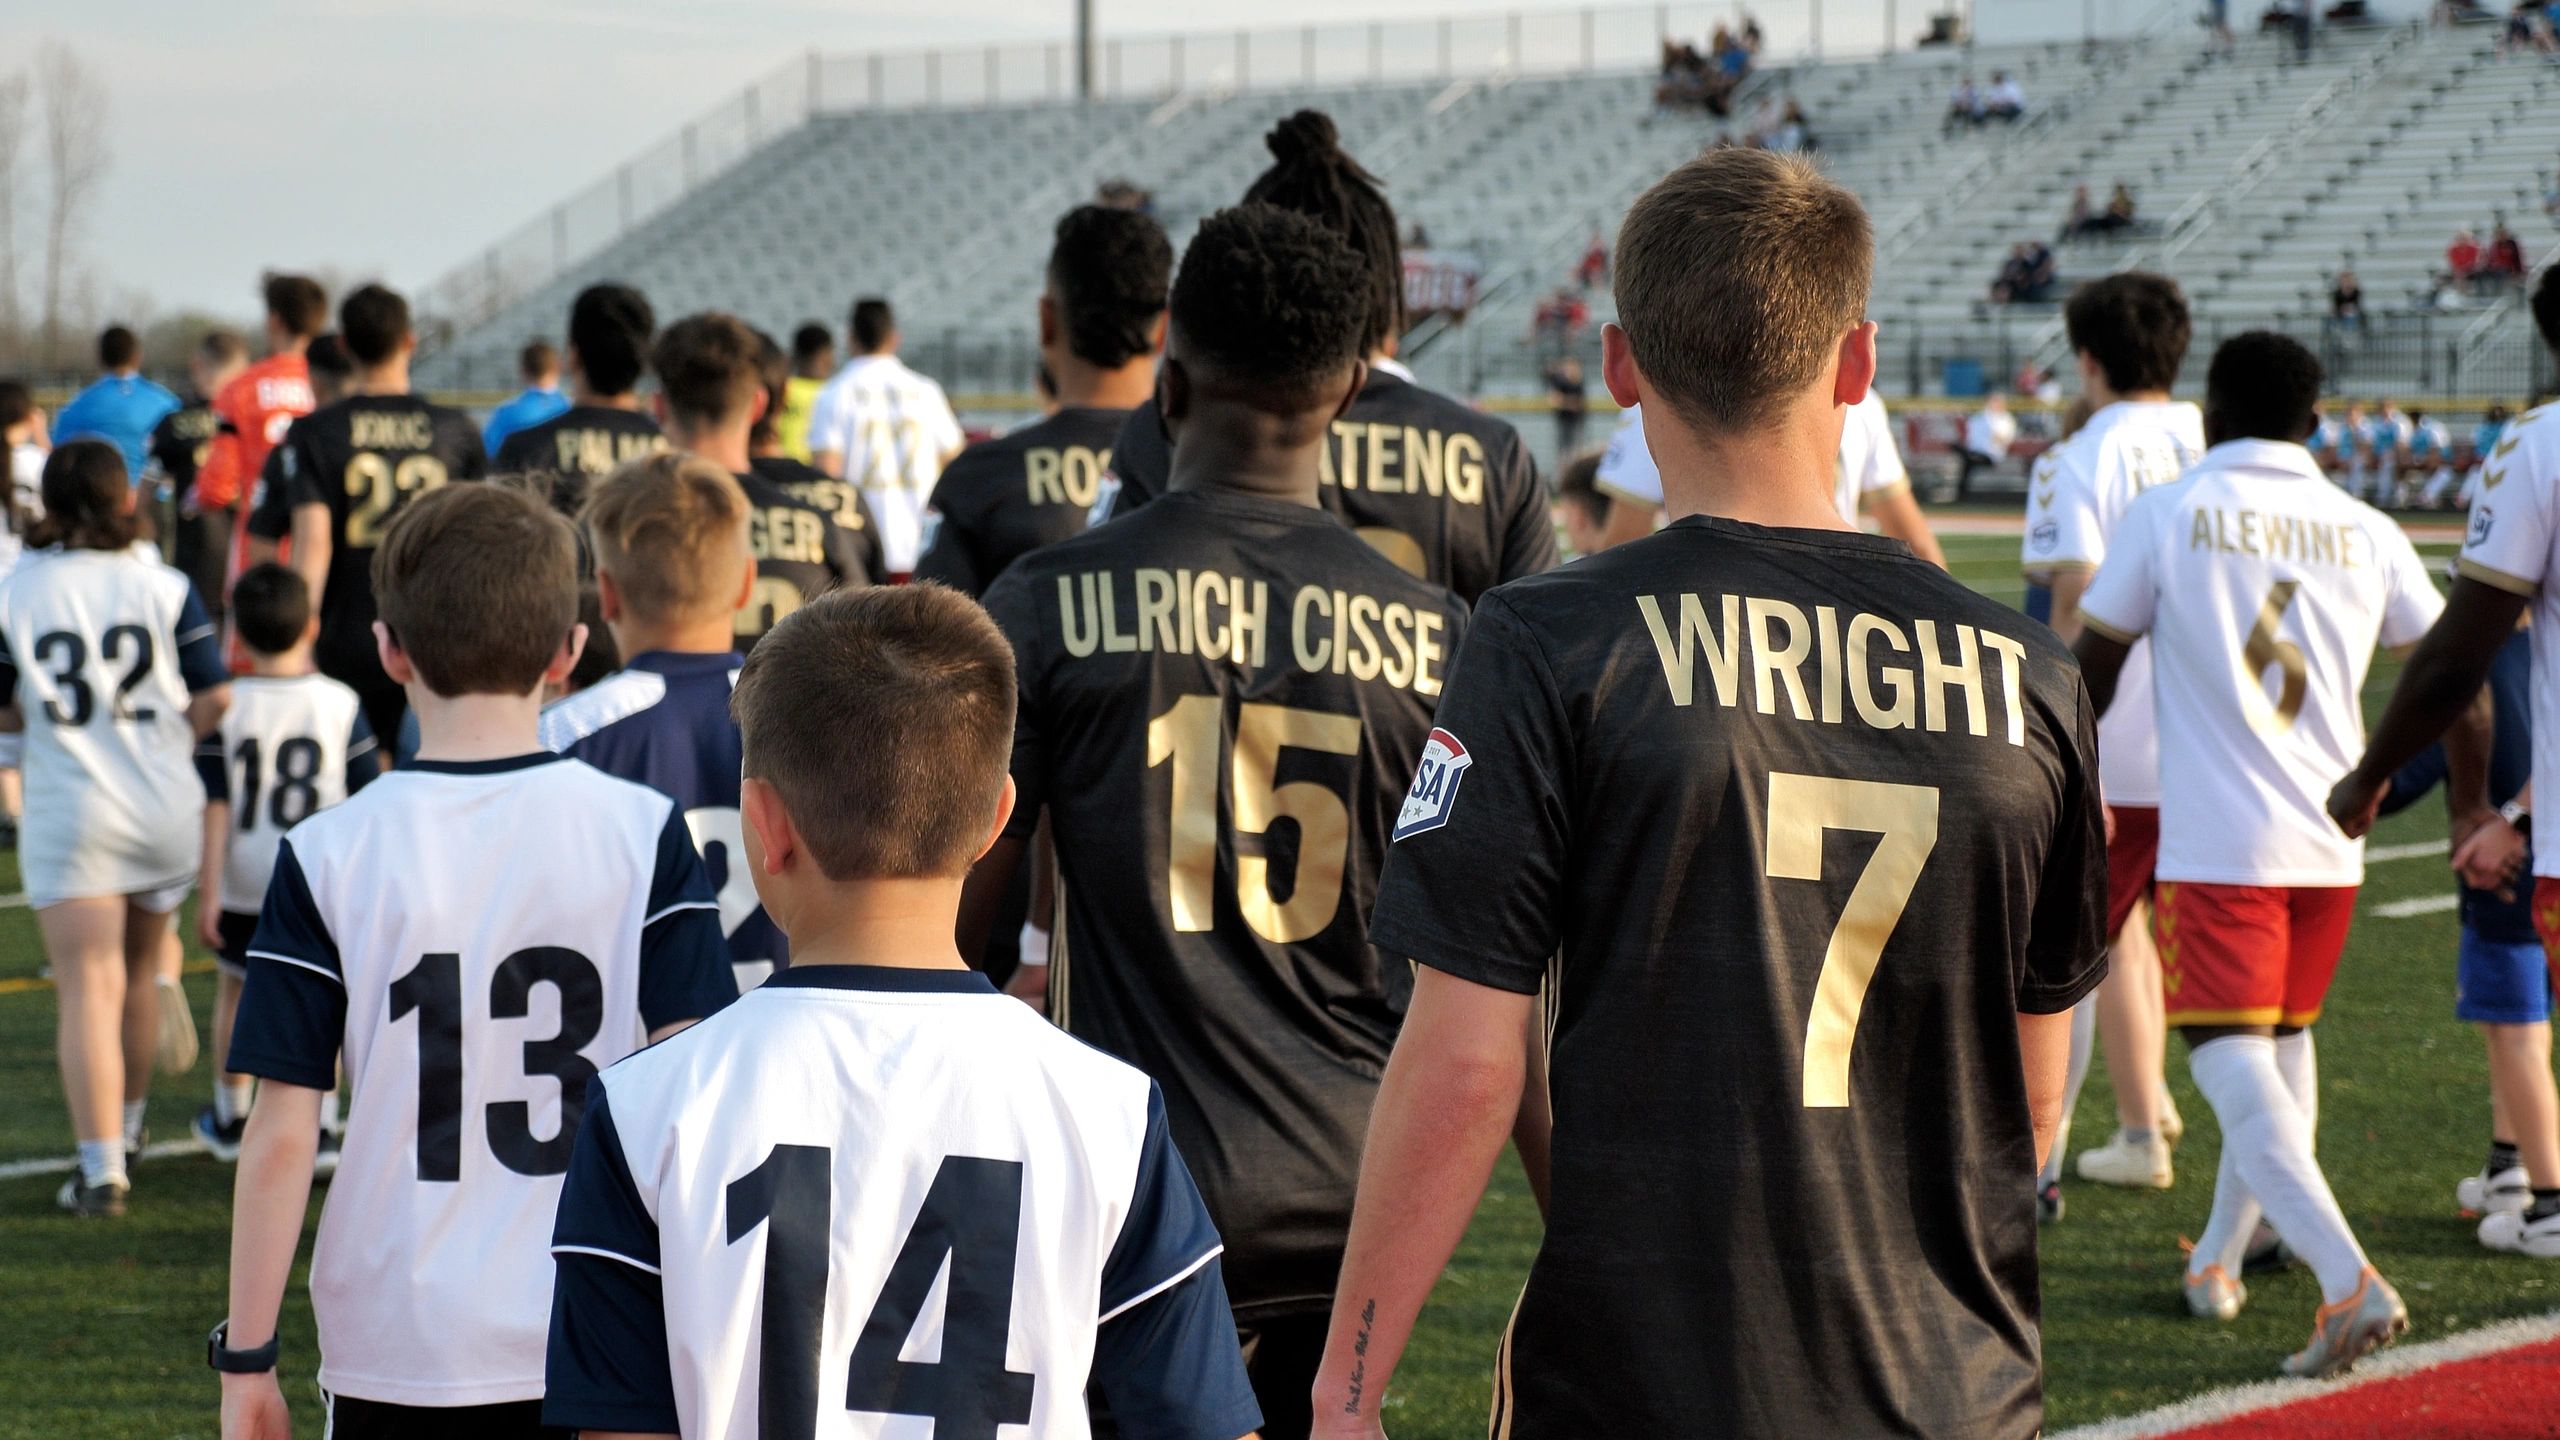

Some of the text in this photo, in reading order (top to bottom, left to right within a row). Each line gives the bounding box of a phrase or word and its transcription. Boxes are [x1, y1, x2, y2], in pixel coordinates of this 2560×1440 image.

[2190, 506, 2359, 570] ALEWINE
[34, 624, 157, 727] 32
[1057, 568, 1443, 697] ULRICH CISSE
[1635, 593, 2028, 748] WRIGHT
[2243, 579, 2307, 736] 6
[235, 736, 323, 831] 18
[1147, 693, 1363, 945] 15
[1765, 771, 1940, 1109] 7
[389, 945, 604, 1182] 13
[726, 1143, 1036, 1440] 14
